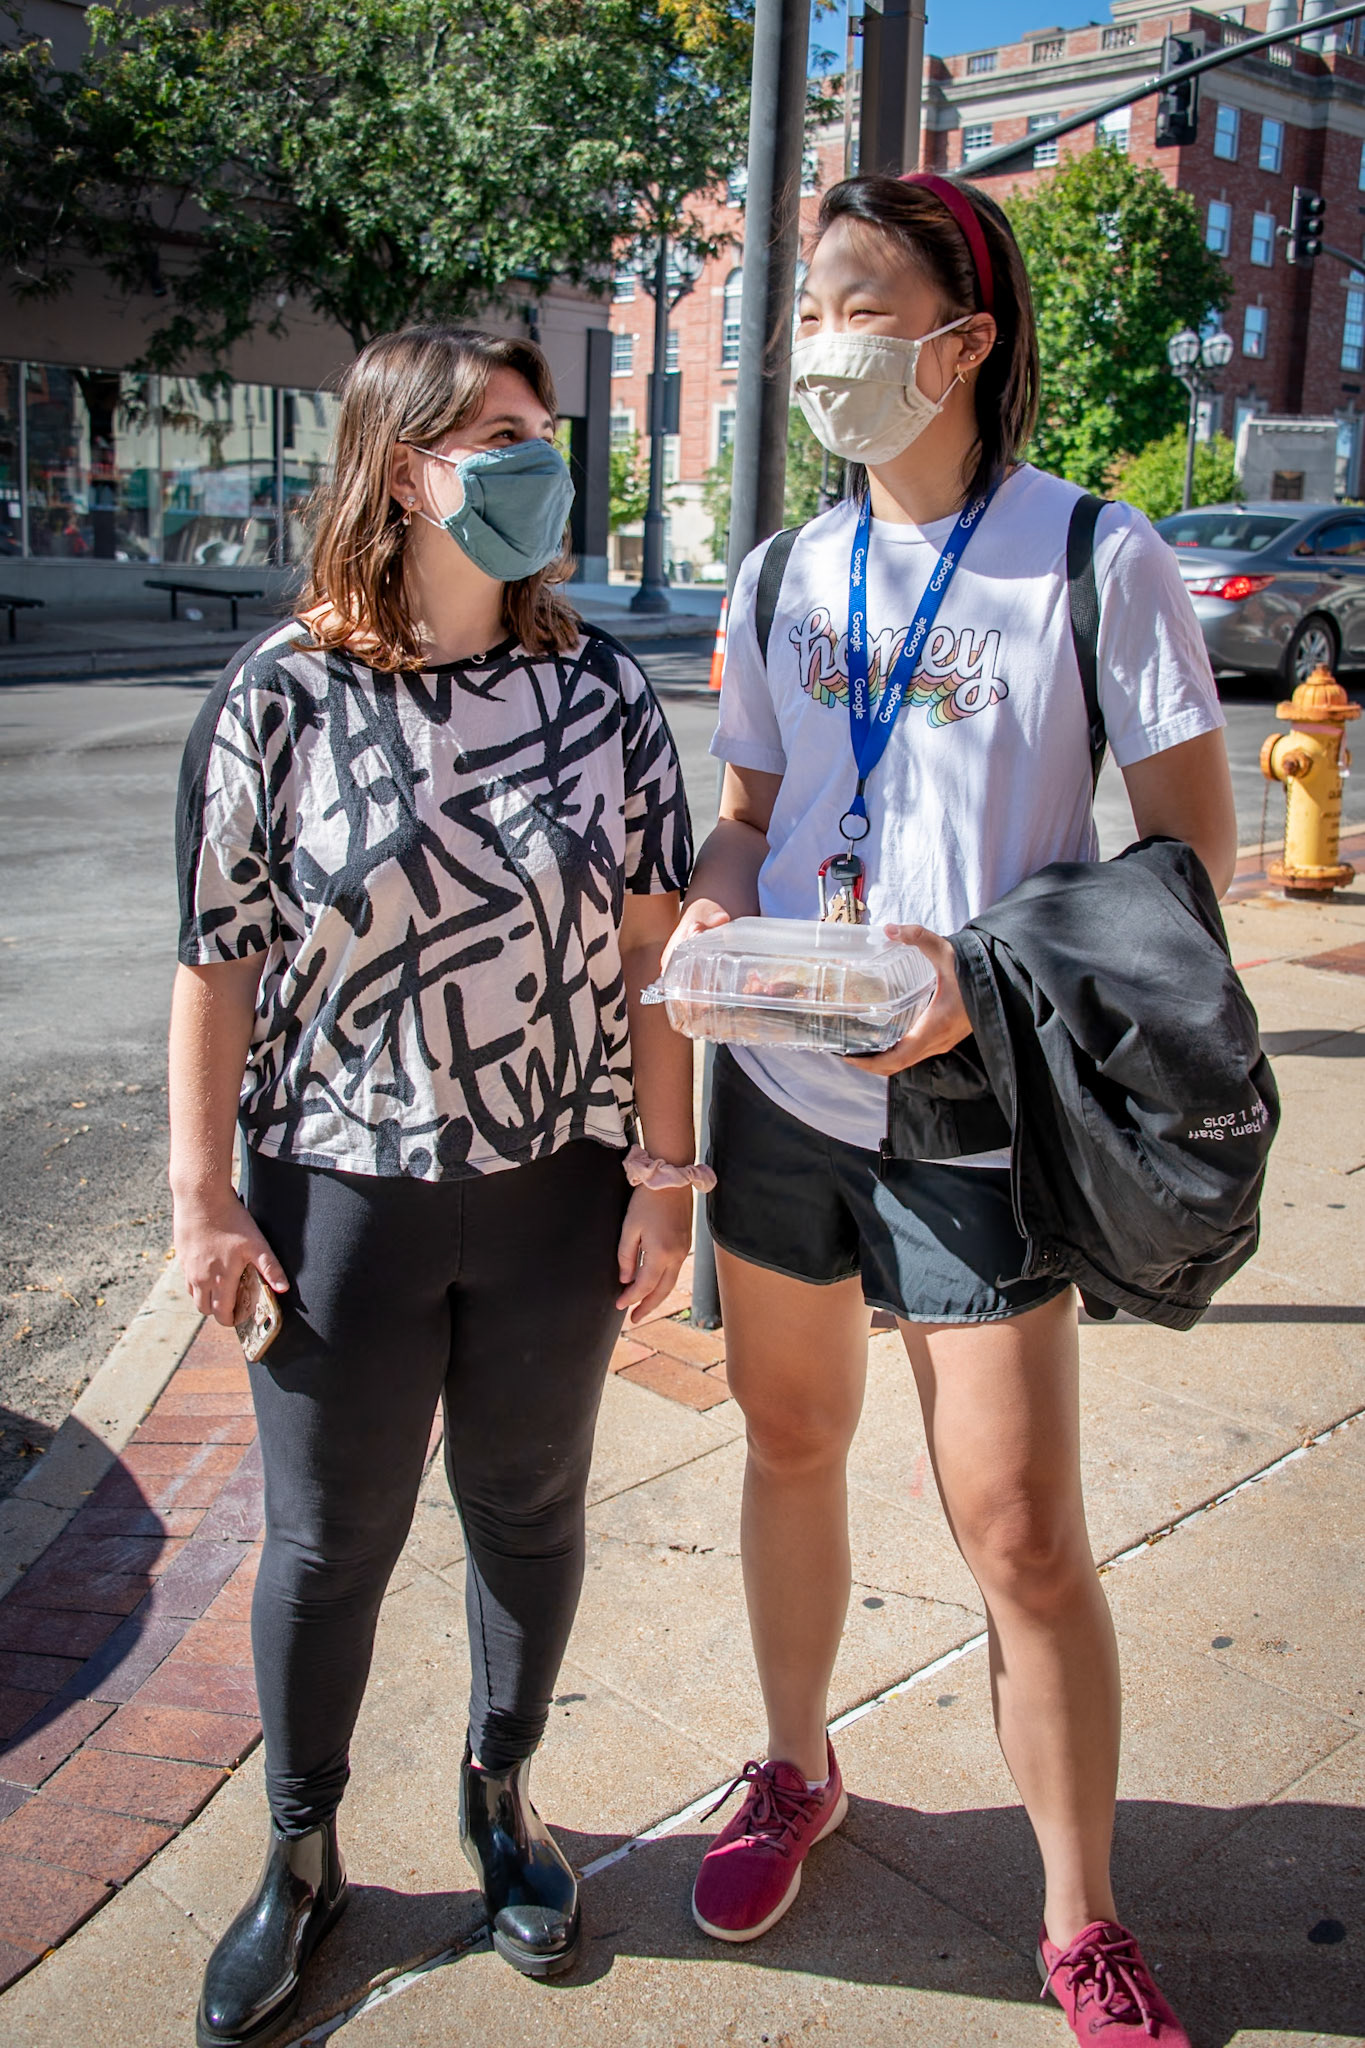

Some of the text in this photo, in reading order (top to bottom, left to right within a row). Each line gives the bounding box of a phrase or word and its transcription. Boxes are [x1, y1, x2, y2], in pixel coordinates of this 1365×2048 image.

[851, 548, 865, 587] Google
[930, 552, 955, 591] Google
[850, 611, 863, 653] Google
[904, 617, 927, 657] Google
[852, 678, 866, 719] Google
[879, 683, 902, 723] Google
[1188, 1118, 1261, 1141] Ram Staff
[1203, 1113, 1236, 1129] 2015
